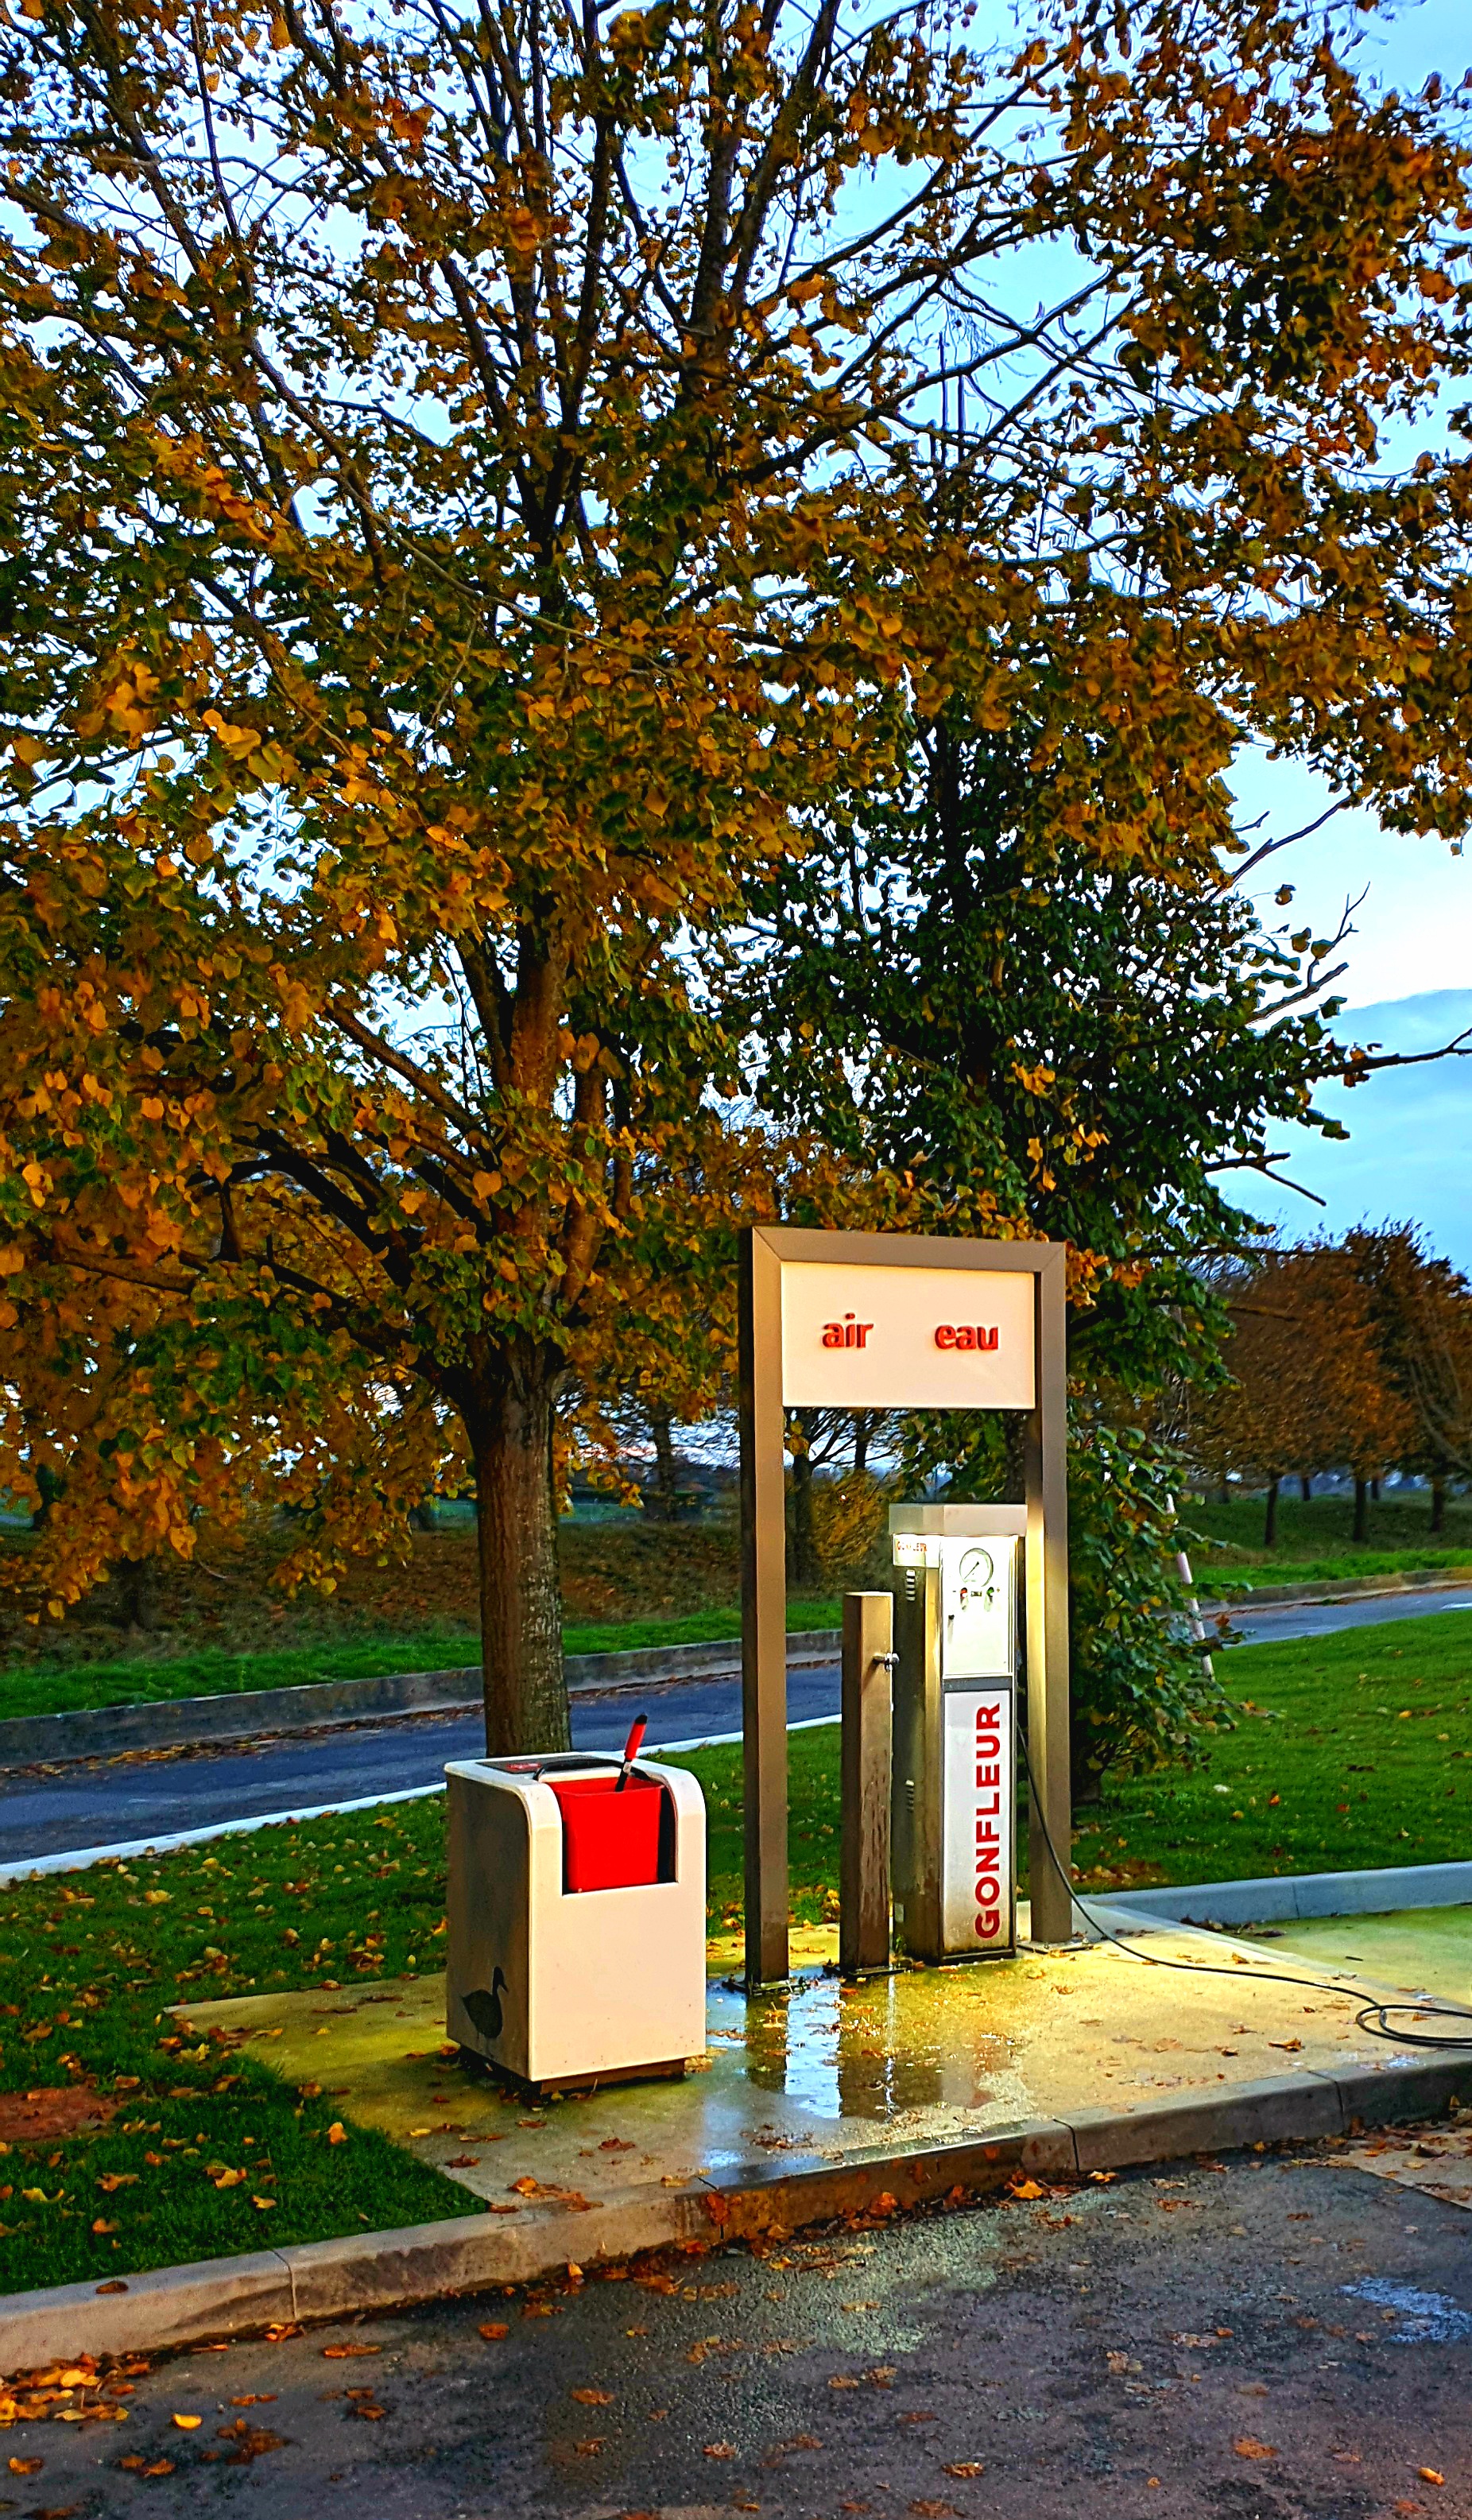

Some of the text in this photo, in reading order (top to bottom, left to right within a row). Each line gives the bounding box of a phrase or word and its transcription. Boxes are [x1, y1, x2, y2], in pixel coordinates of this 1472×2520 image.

[821, 1312, 1000, 1351] air eau
[897, 1540, 928, 1553] GLEUR
[974, 1703, 1001, 1940] GONFLEUR
